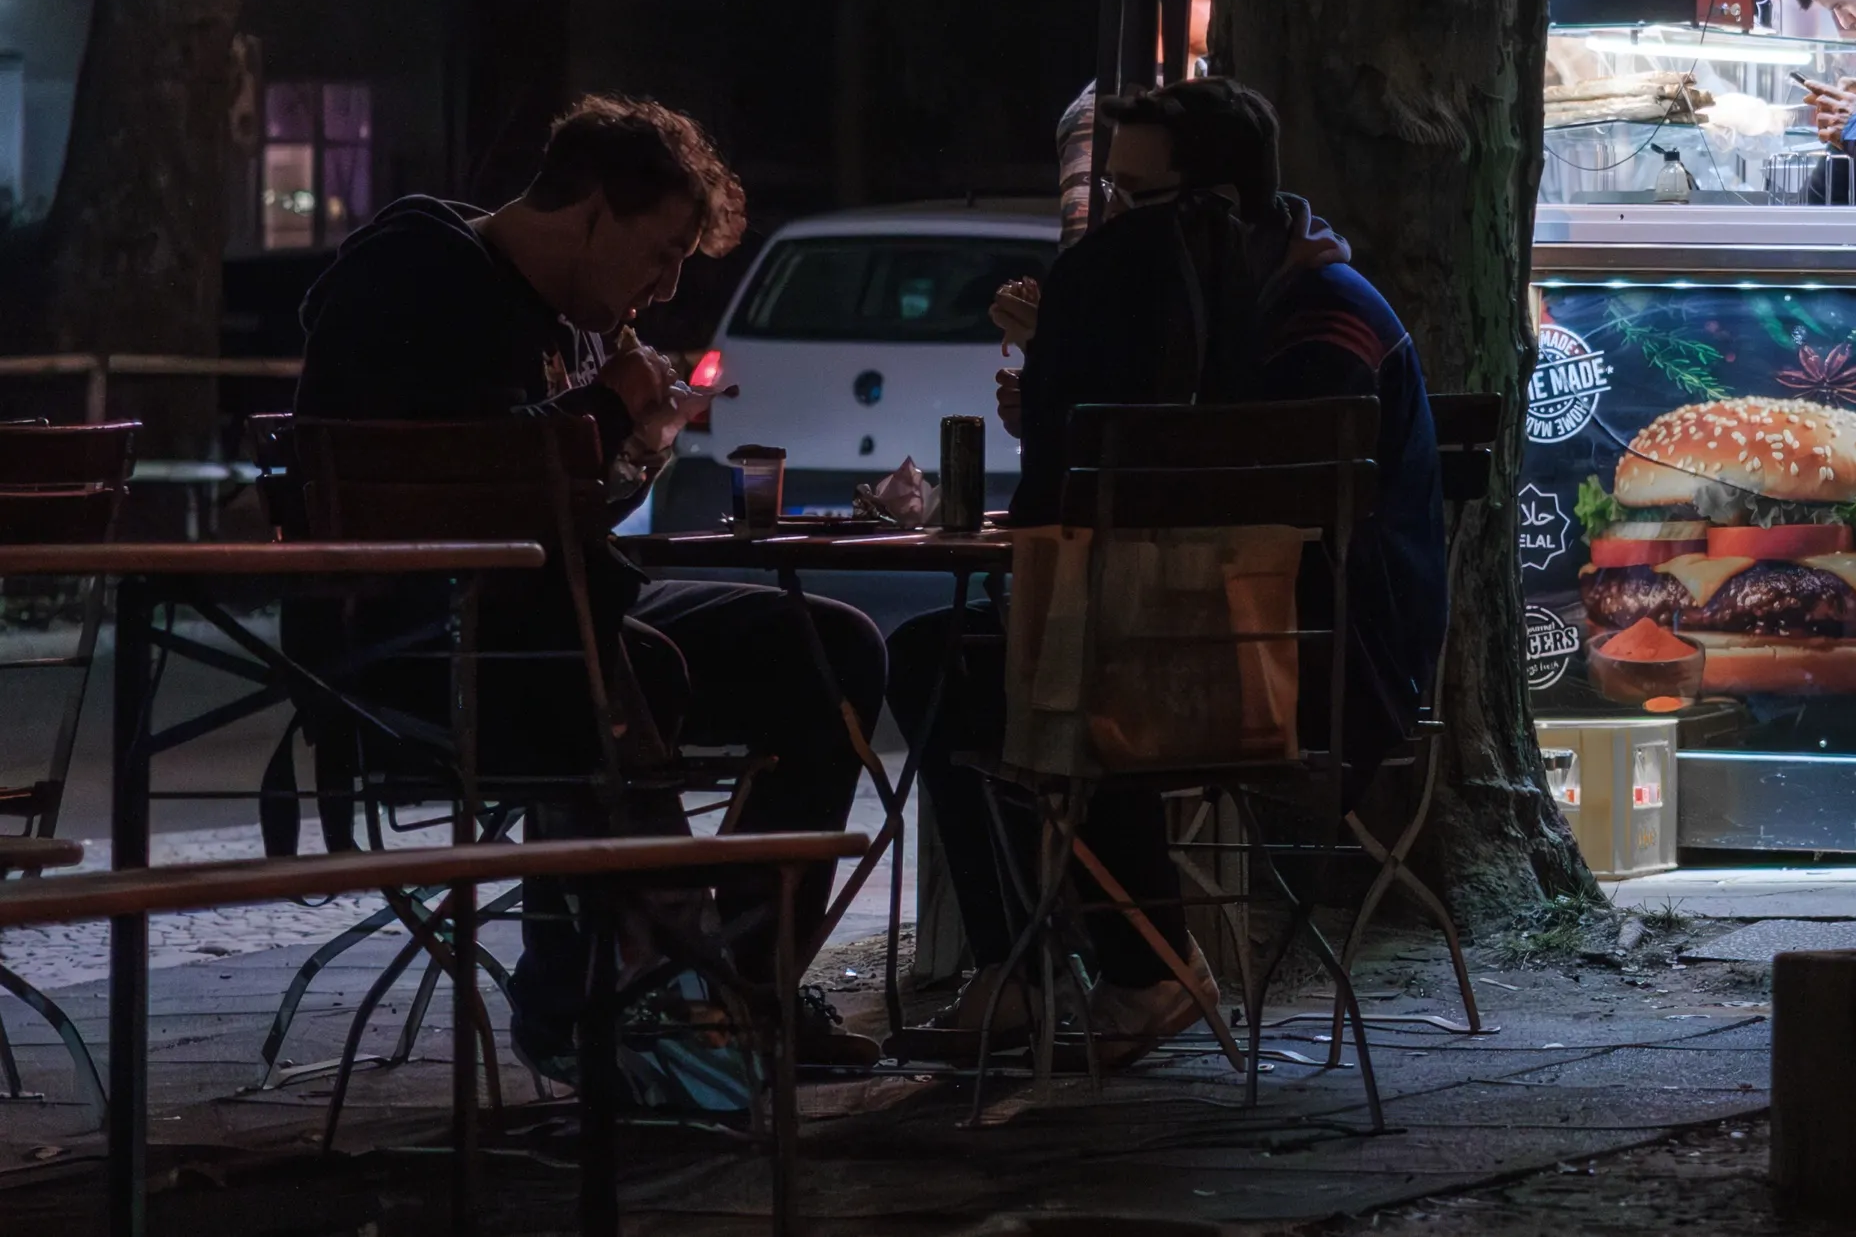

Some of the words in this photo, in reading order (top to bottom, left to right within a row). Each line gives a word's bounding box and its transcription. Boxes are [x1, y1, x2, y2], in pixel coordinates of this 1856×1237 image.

[1539, 330, 1577, 355] MADE
[1549, 357, 1608, 396] MADE
[1526, 417, 1553, 438] MAD
[1554, 400, 1590, 436] HOME
[1519, 533, 1556, 549] ELAL
[1527, 628, 1576, 656] GERS
